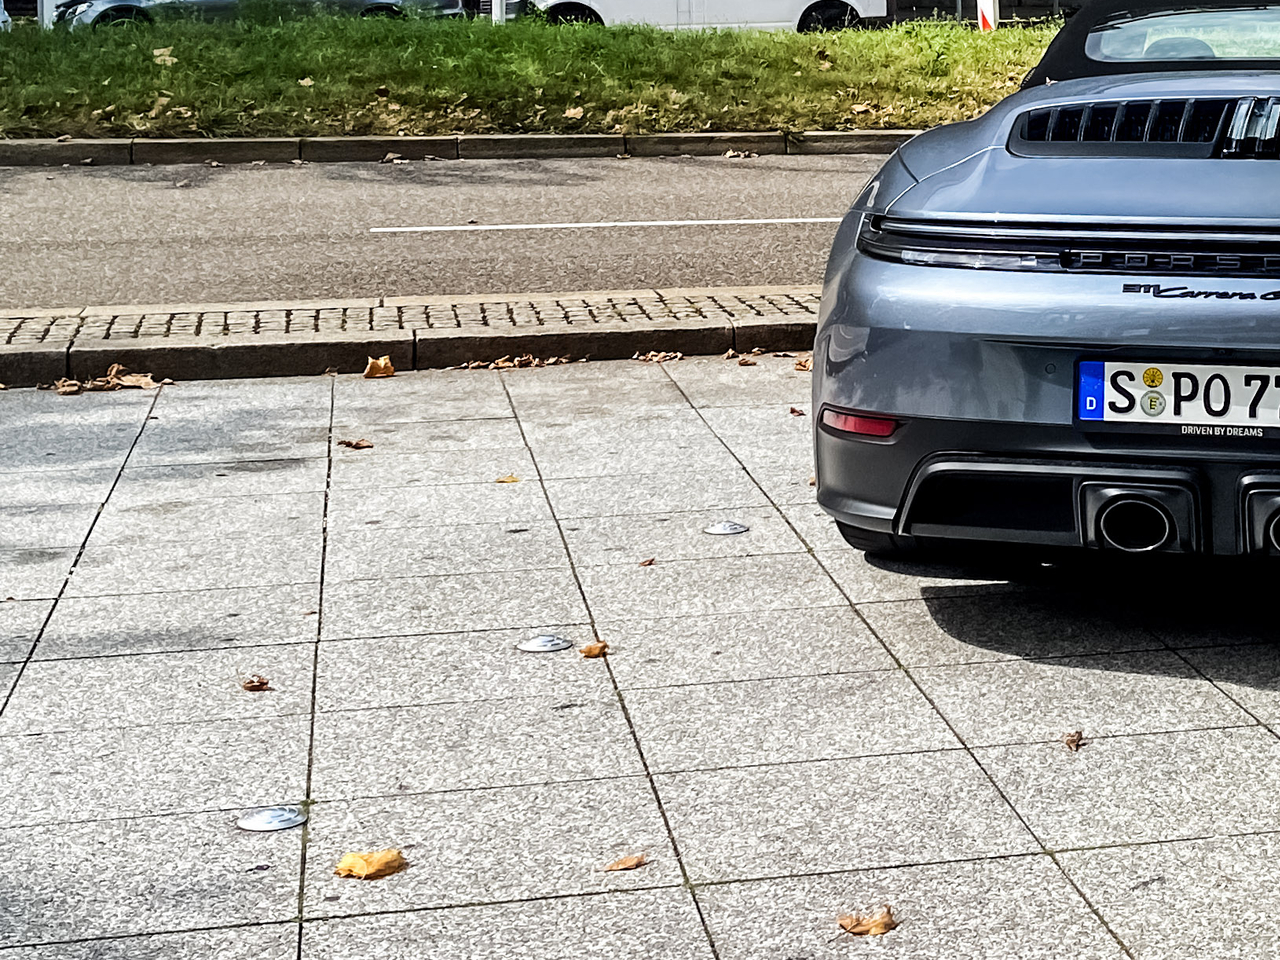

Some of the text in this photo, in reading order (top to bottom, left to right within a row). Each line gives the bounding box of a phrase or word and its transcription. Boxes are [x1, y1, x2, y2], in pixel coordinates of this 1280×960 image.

[1153, 286, 1257, 300] Carrera
[1108, 370, 1136, 414] S
[1171, 372, 1231, 417] PO
[1086, 397, 1096, 410] D
[1181, 425, 1263, 437] DRIVEN BY DREAMS
